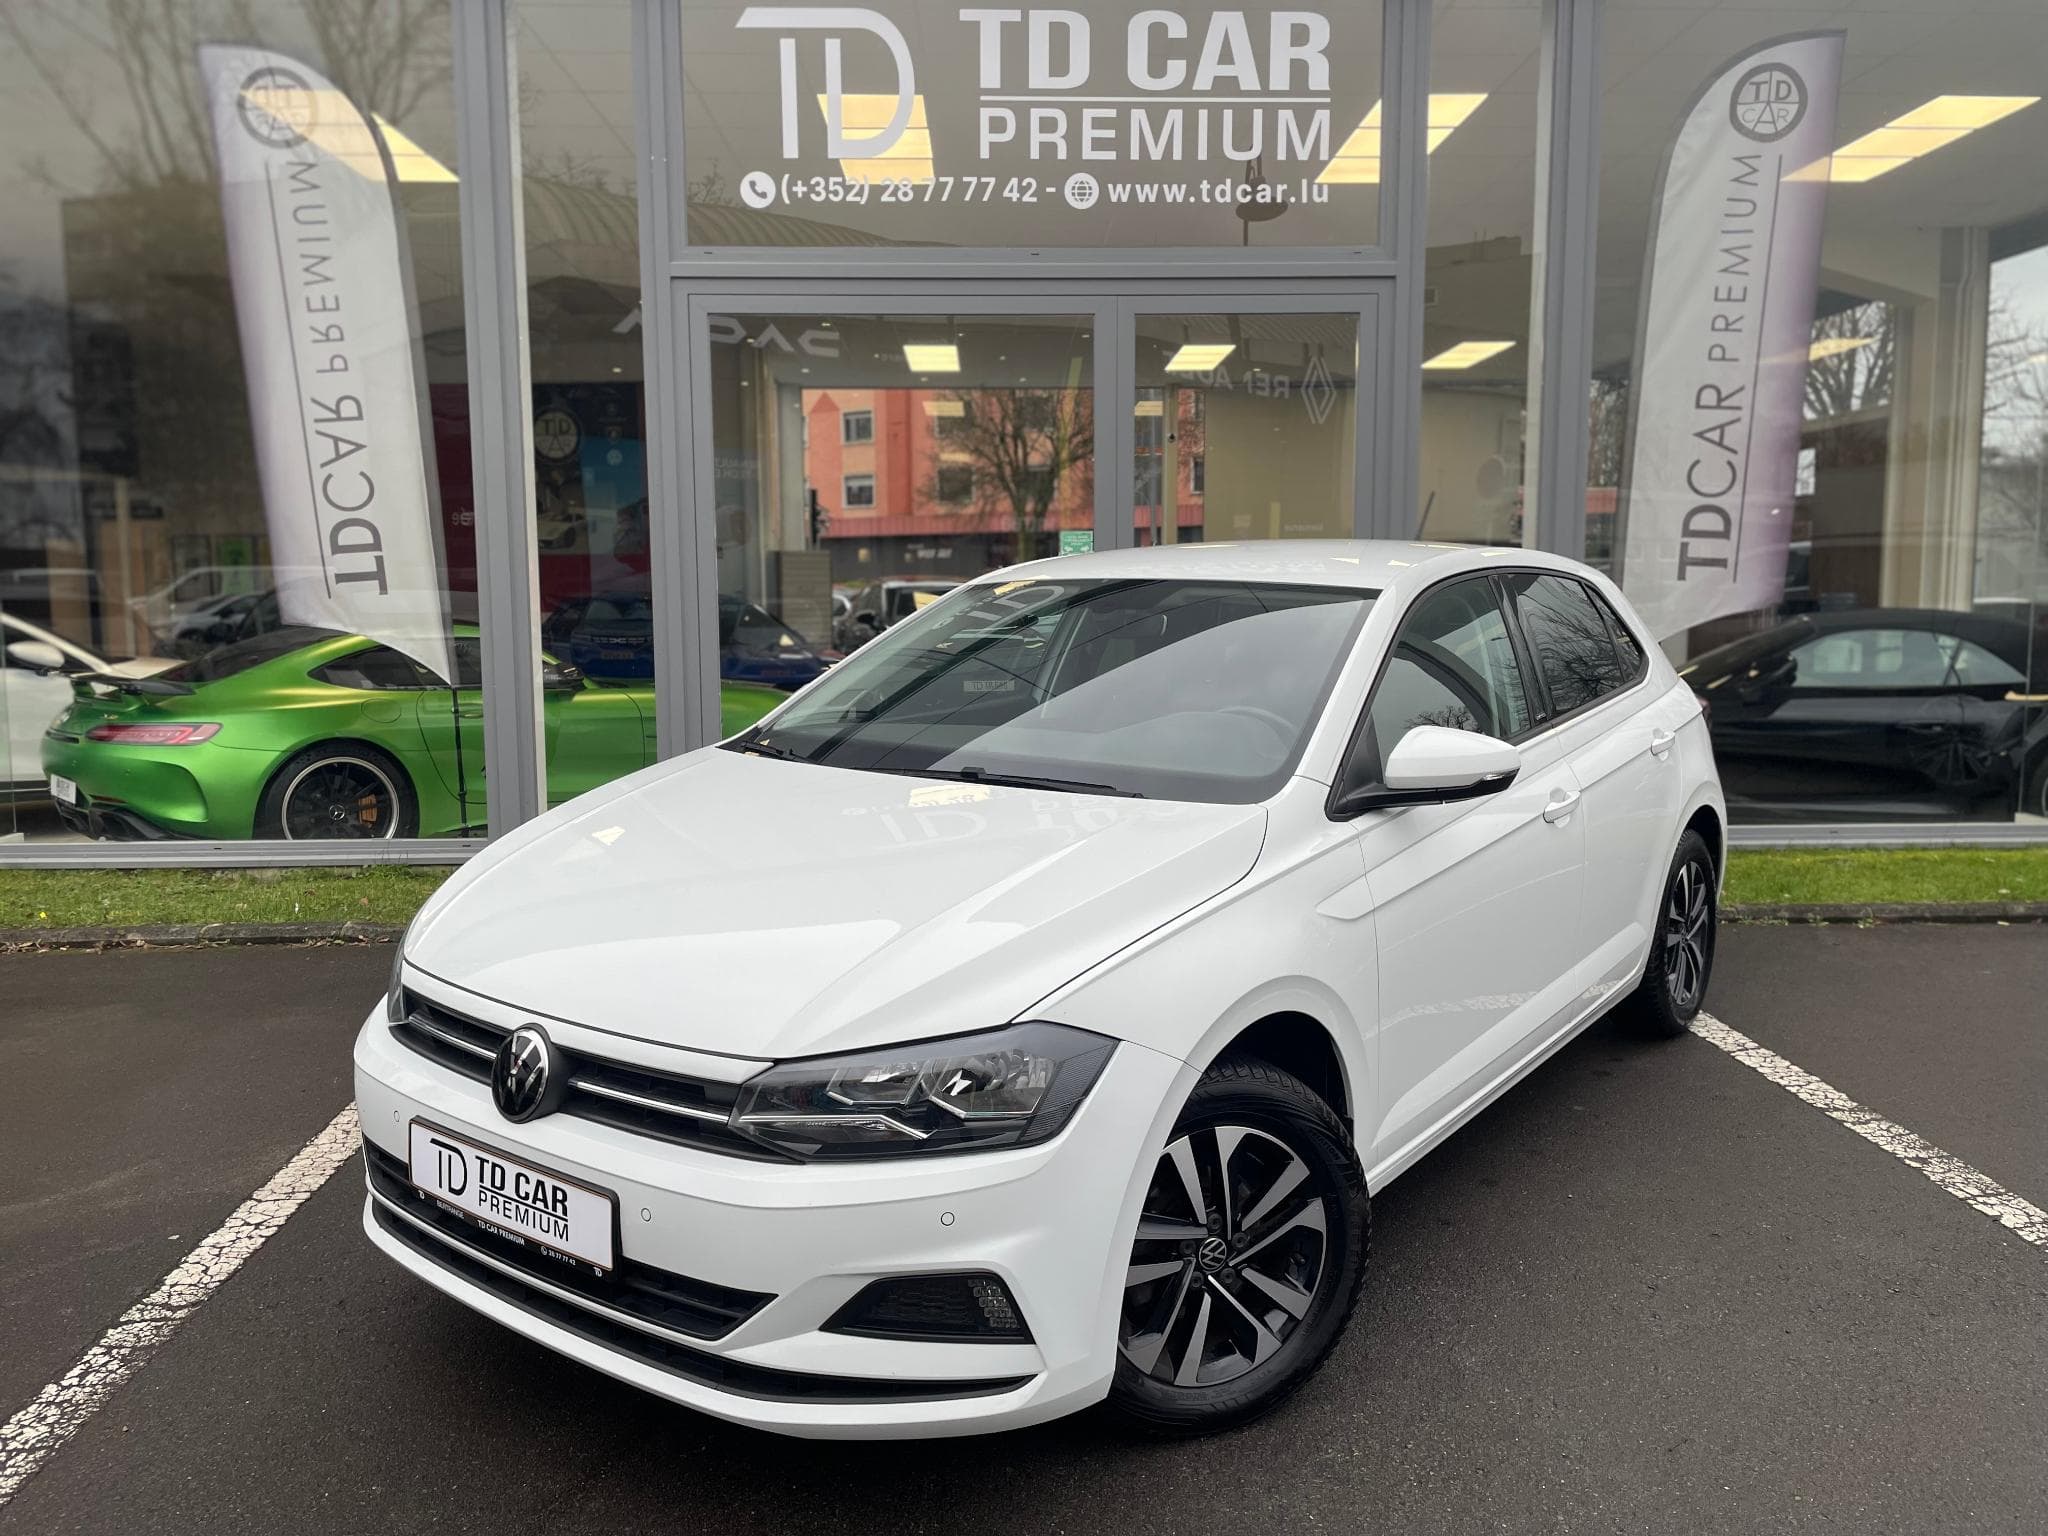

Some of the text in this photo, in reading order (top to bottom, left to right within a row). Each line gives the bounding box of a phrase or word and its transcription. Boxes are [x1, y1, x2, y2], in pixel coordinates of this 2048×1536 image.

[959, 9, 1331, 91] TD CAR
[1748, 79, 1792, 102] TD
[979, 107, 1331, 161] PREMIUM
[781, 173, 870, 204] (+352)
[880, 177, 914, 202] 28
[923, 177, 955, 202] 77
[962, 177, 996, 202] 77
[1003, 177, 1038, 203] 42
[1107, 178, 1329, 203] www.tdcar.lu
[1676, 155, 1763, 581] TDCAR PREMIUM
[475, 1155, 568, 1218] TD CAR
[477, 1219, 486, 1230] TD
[486, 1223, 498, 1235] CAR
[478, 1189, 569, 1242] PREMIUM
